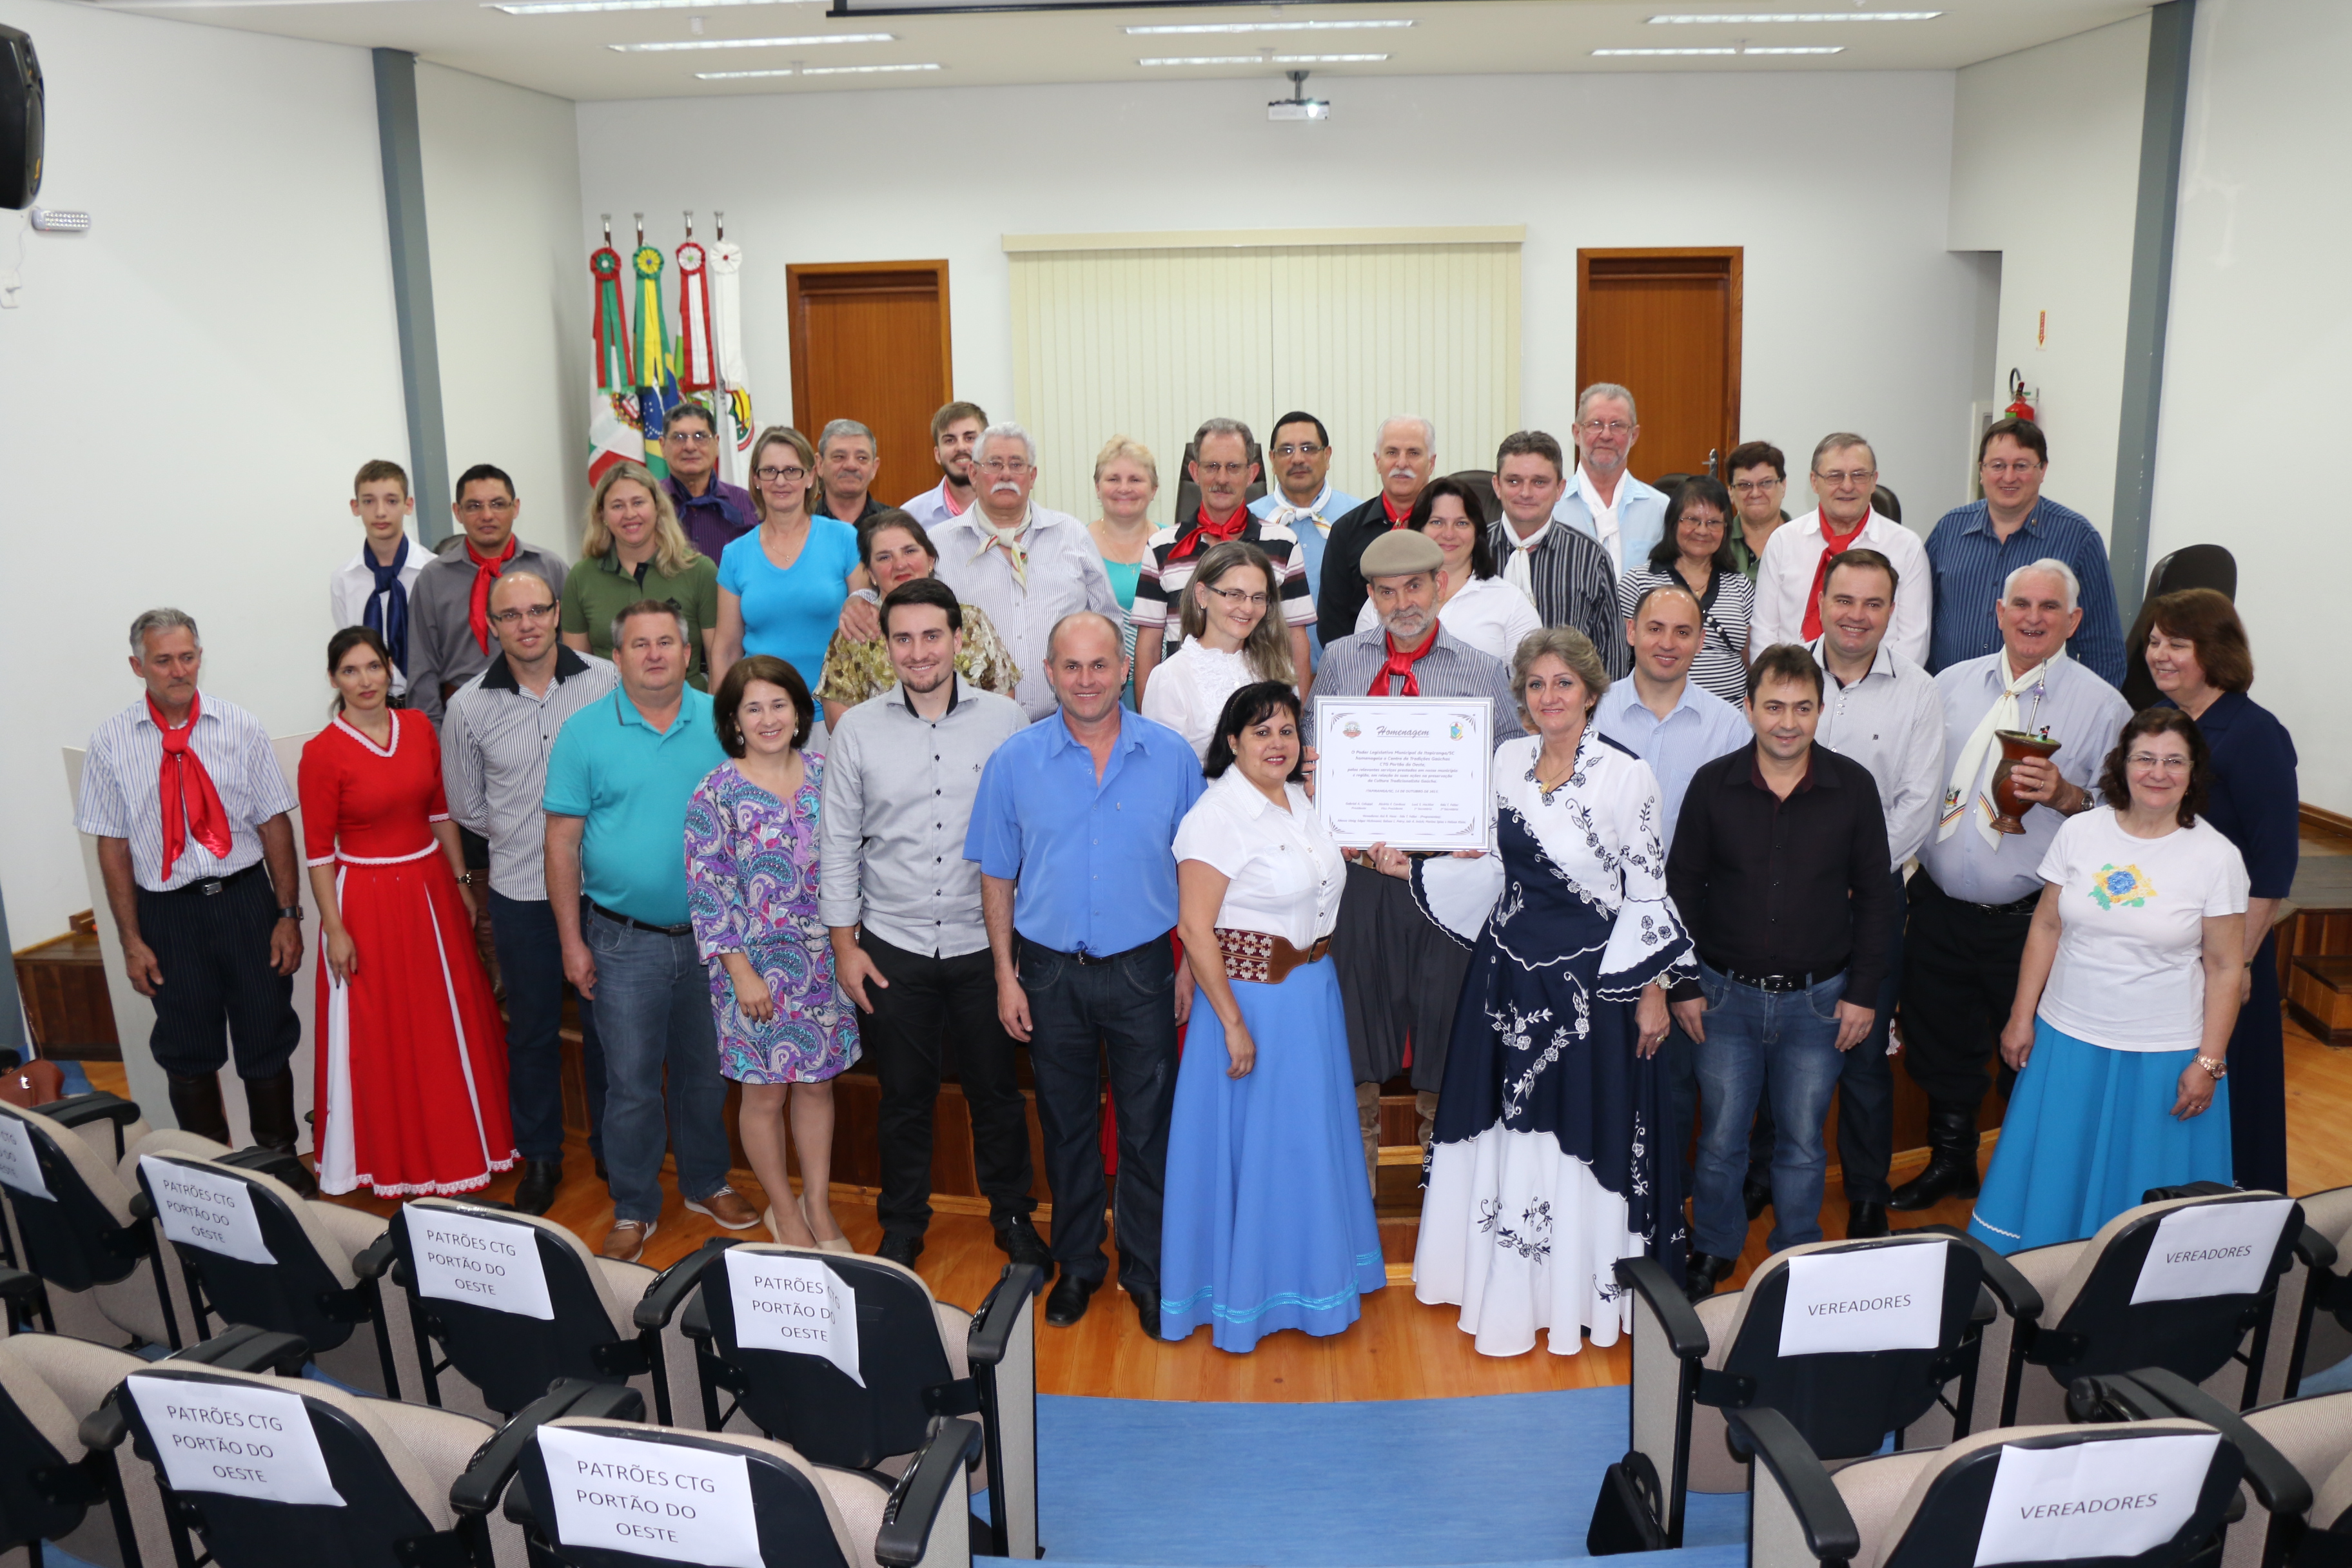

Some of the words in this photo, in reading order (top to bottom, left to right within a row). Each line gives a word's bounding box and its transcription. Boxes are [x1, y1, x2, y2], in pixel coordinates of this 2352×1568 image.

[1376, 725, 1429, 738] Homenagem
[163, 1180, 211, 1202] PATRÕES
[213, 1193, 235, 1208] CTG
[166, 1200, 210, 1221] PORTÃO
[212, 1213, 230, 1226] DO
[191, 1226, 226, 1243] OESTE
[427, 1230, 486, 1251] PATRÕES
[490, 1241, 516, 1256] CTG
[427, 1252, 481, 1272] PORTÃO
[485, 1263, 505, 1277] DO
[2166, 1245, 2252, 1264] VEREADORES
[455, 1279, 496, 1295] OESTE
[754, 1276, 824, 1295] PATRÕES
[827, 1286, 841, 1309] CTG
[752, 1300, 815, 1318] PORTÃO
[821, 1308, 836, 1324] DO
[1808, 1294, 1911, 1316] VEREADORES
[781, 1326, 828, 1342] OESTE
[166, 1406, 244, 1427] PATRÕES
[248, 1415, 283, 1431] CTG
[172, 1435, 242, 1455] PORTÃO
[246, 1444, 273, 1458] DO
[213, 1465, 268, 1483] OESTE
[577, 1460, 669, 1487] PATRÕES
[675, 1475, 716, 1493] CTG
[576, 1489, 659, 1514] PORTÃO
[666, 1504, 696, 1519] DO
[2021, 1493, 2159, 1520] VEREADORES
[616, 1522, 679, 1544] OESTE
